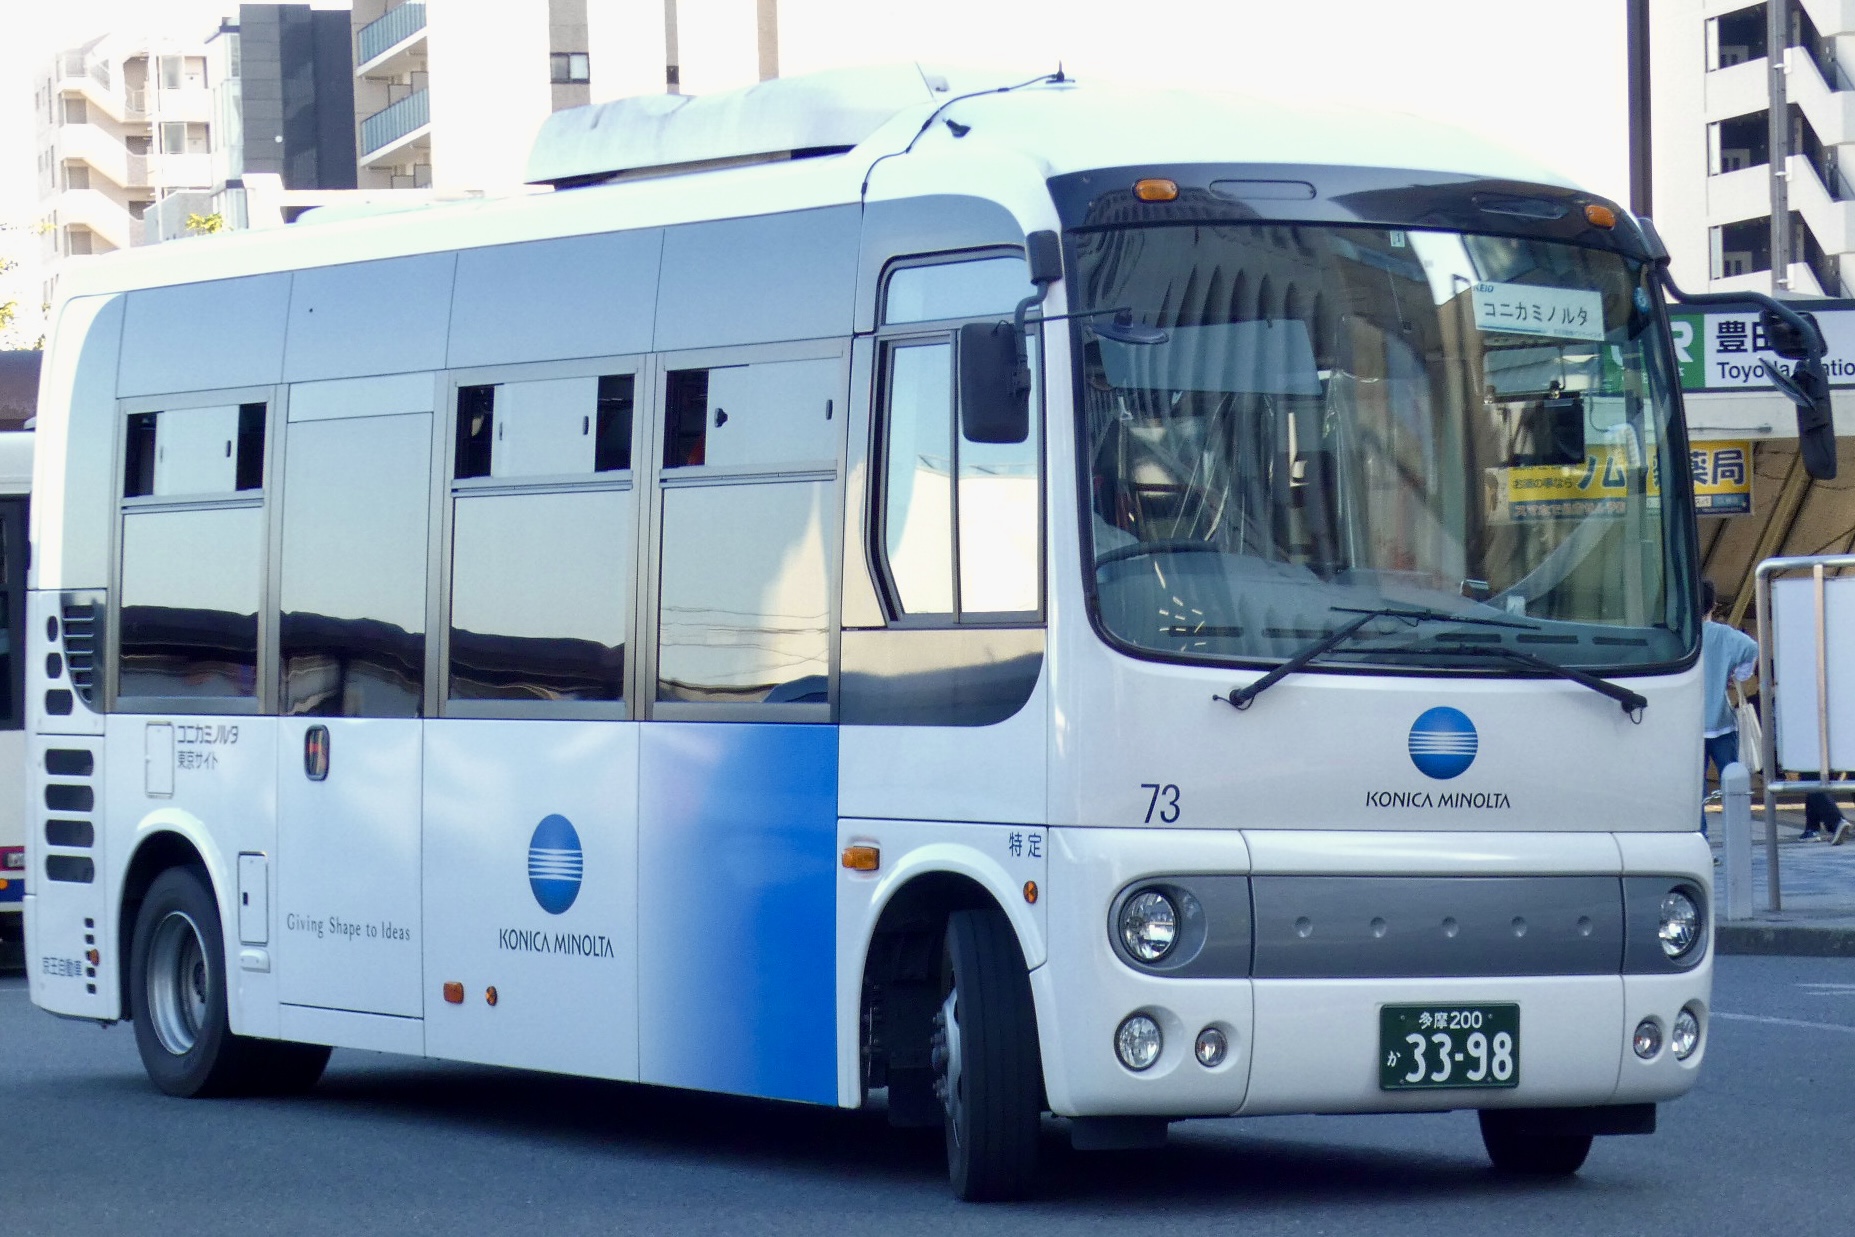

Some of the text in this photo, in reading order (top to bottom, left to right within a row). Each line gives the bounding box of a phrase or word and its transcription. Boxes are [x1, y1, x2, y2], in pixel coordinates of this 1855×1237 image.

[1484, 302, 1588, 326] コニカミノルタ
[1716, 361, 1790, 383] Toyoa
[178, 724, 239, 744] コニカミノルタ
[178, 750, 218, 770] 東京サイト
[1140, 783, 1181, 824] 73
[1366, 791, 1511, 809] KONICA MINOLTA
[1009, 831, 1042, 858] 特定
[286, 912, 410, 941] Giving Shape to Ideas
[499, 928, 614, 958] KONICA MINOLTA
[1418, 1011, 1483, 1030] 多摩200
[1386, 1031, 1514, 1083] か 33-98
